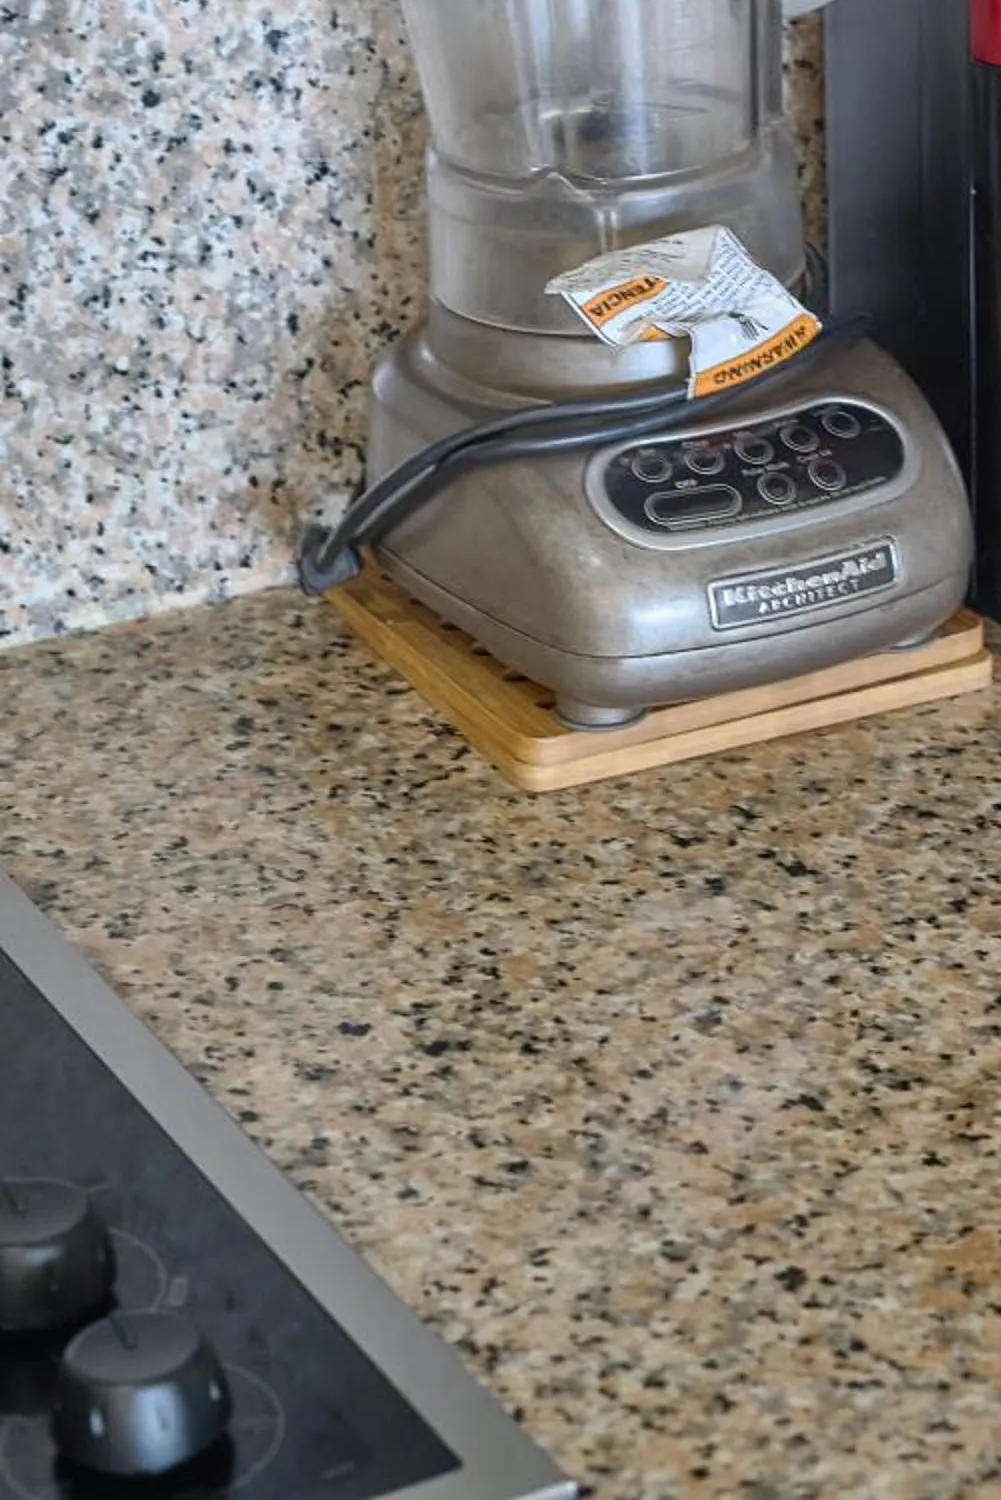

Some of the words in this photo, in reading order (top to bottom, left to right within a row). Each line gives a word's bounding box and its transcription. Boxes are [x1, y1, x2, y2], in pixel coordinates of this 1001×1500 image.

[588, 276, 661, 317] TENCIA
[713, 335, 796, 385] WARNING
[722, 552, 887, 606] KitchenAid
[759, 579, 860, 613] ARCHITECT
